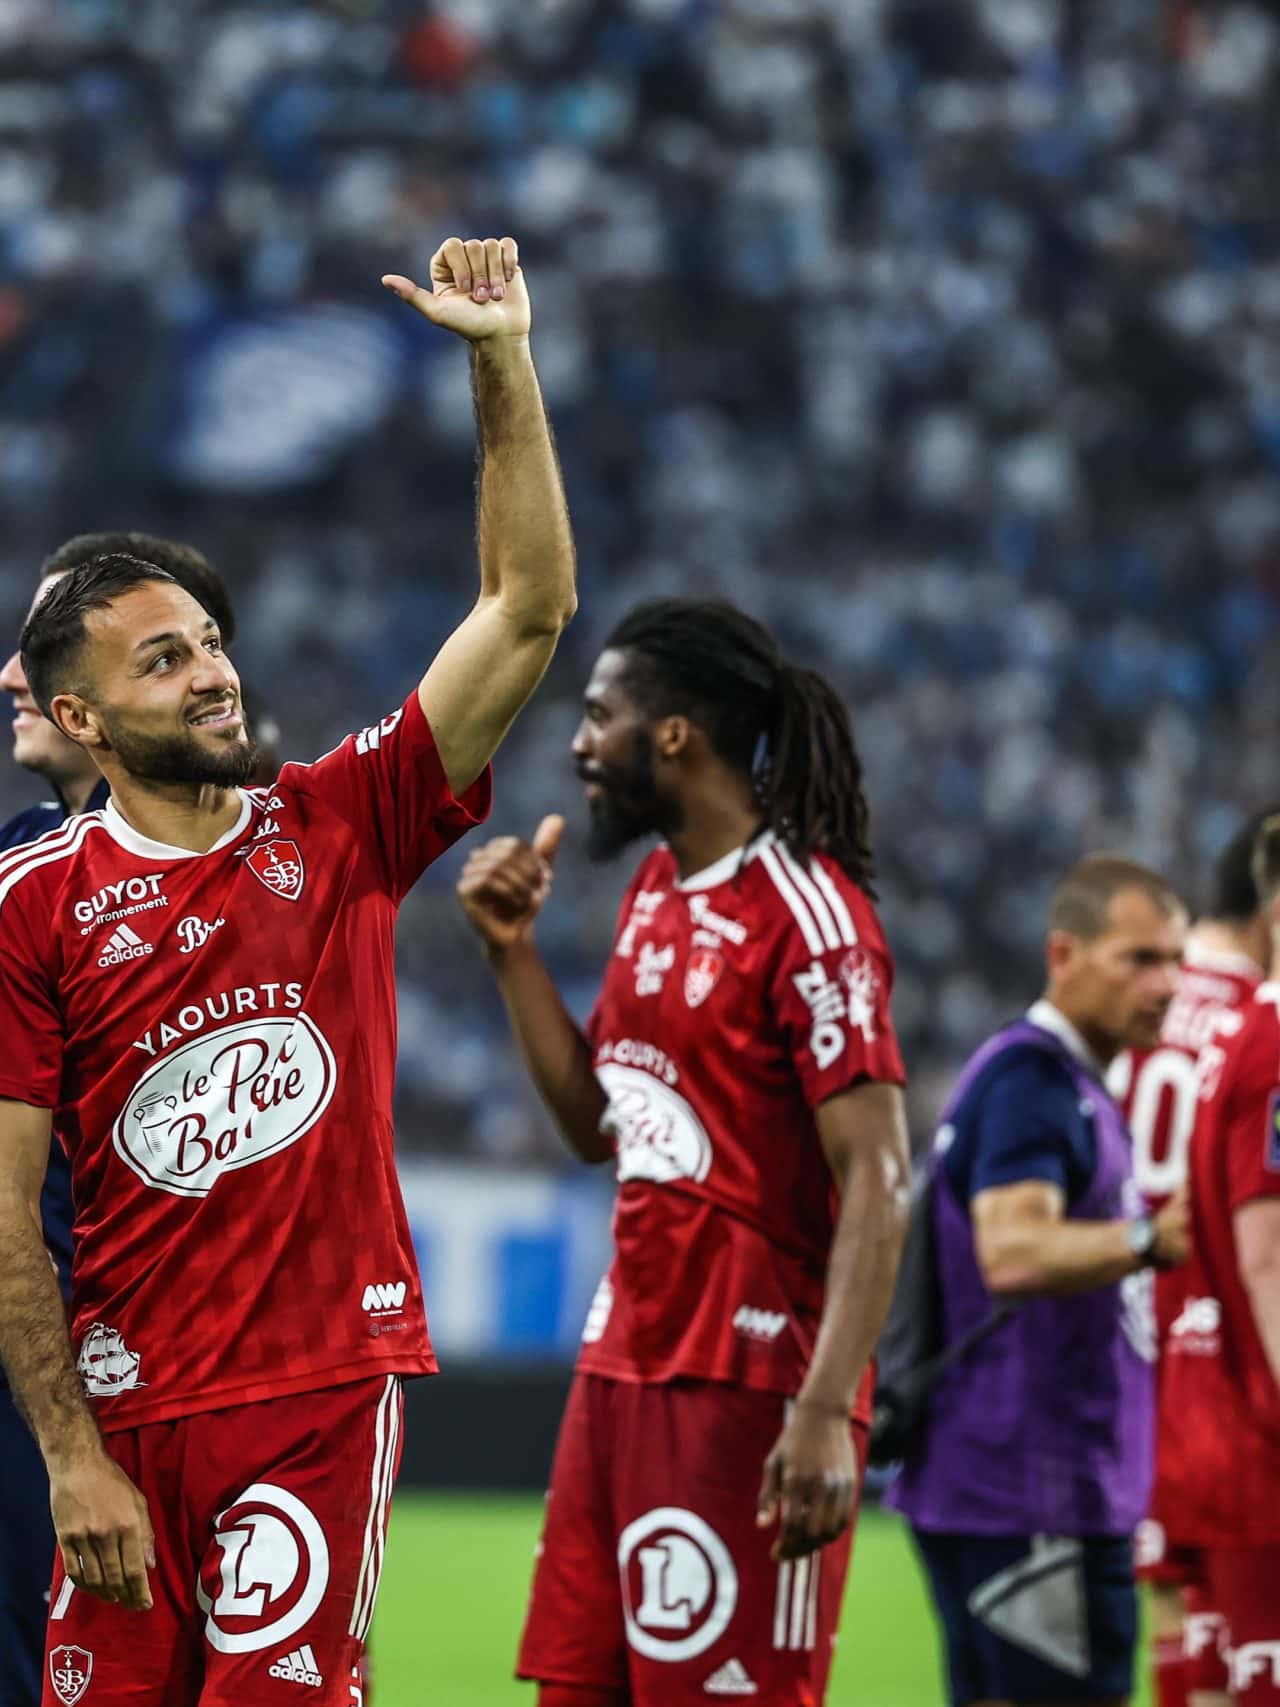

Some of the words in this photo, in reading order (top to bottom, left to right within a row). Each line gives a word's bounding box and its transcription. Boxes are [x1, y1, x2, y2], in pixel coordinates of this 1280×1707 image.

[74, 873, 165, 922] GUYOT
[97, 943, 154, 968] adidas
[132, 982, 303, 1057] YAOURTS
[182, 1069, 211, 1103] le
[55, 1668, 85, 1686] SB
[269, 1664, 323, 1688] adidas
